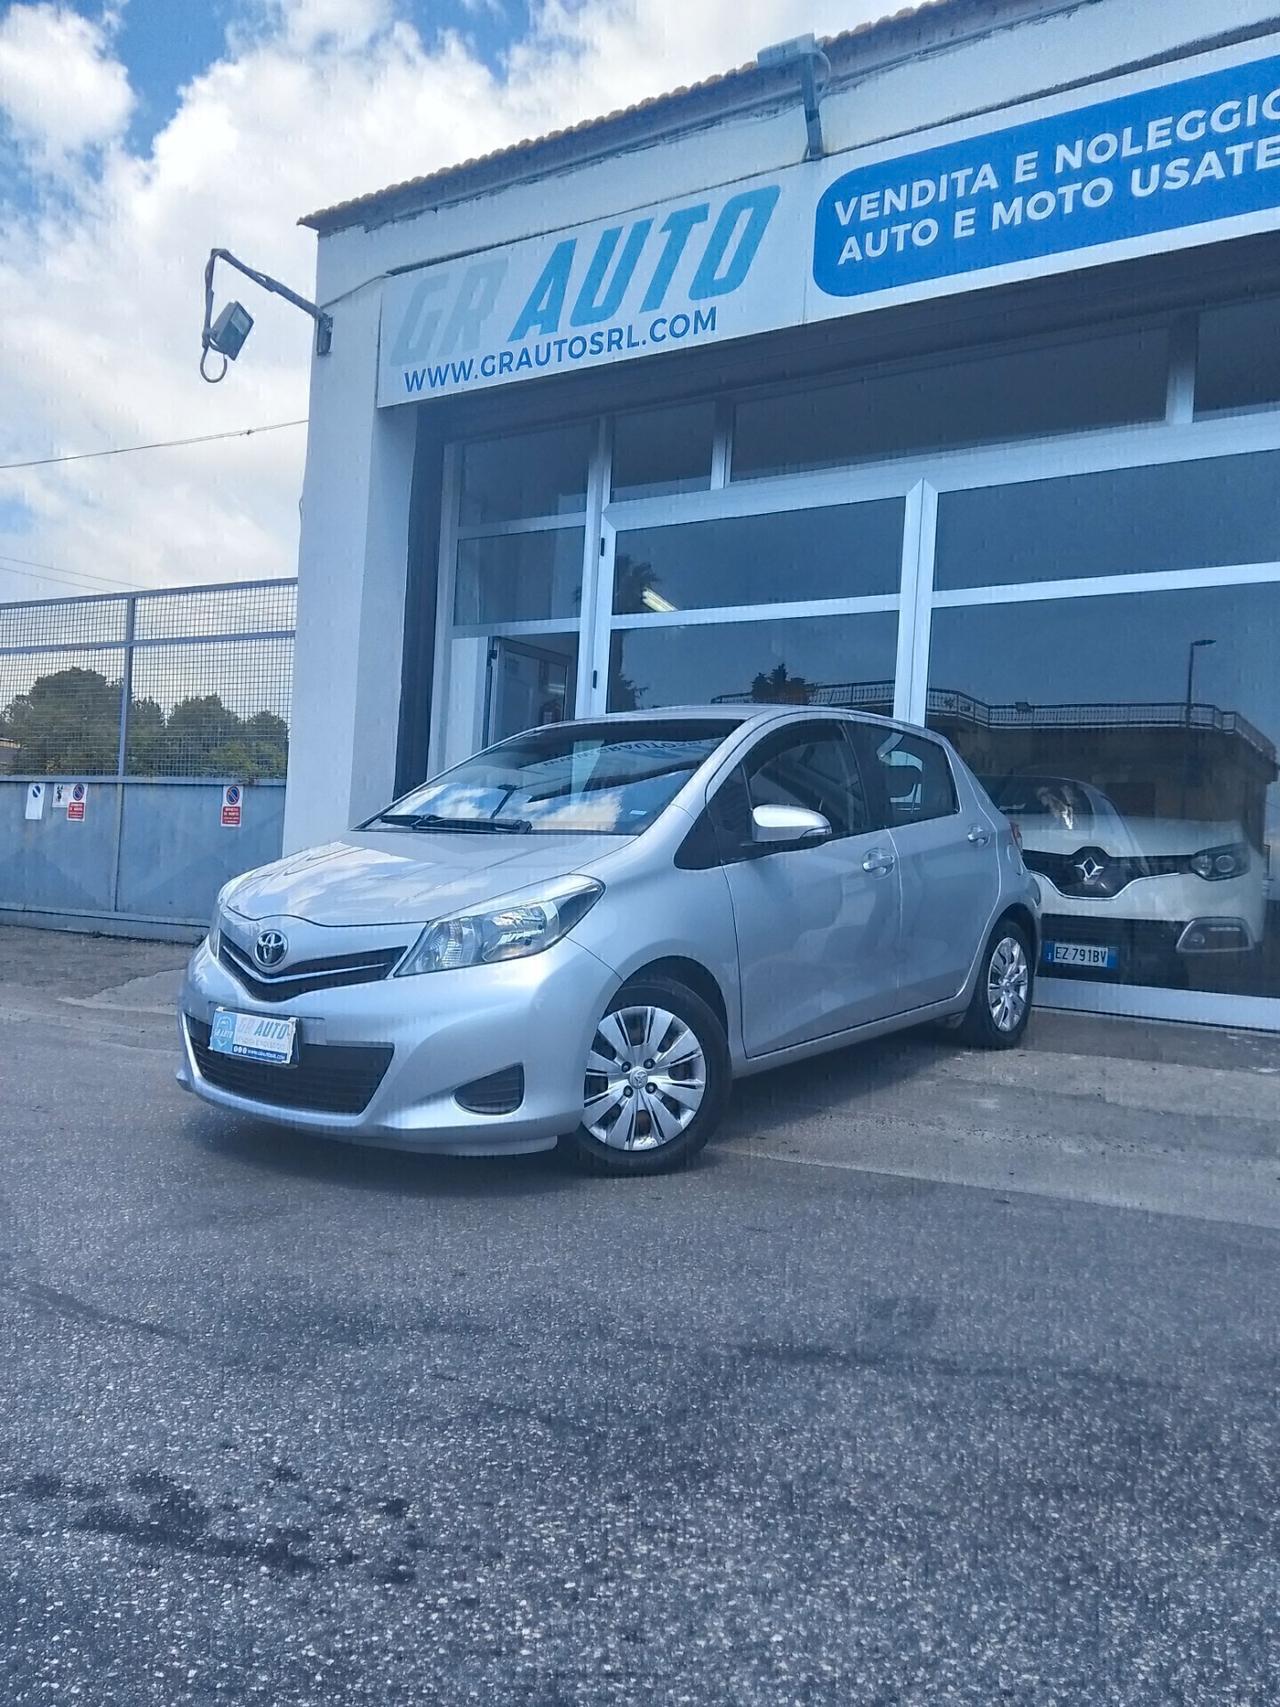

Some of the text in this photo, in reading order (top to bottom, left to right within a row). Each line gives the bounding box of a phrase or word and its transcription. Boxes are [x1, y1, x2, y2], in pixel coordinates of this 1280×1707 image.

[834, 163, 998, 226] VENDITA
[1014, 151, 1039, 184] E
[837, 134, 1280, 266] AUTO E MOTO USATE
[390, 184, 781, 367] GR AUTO
[404, 306, 718, 393] WWW.GRAUTOSRL.COM
[254, 1020, 289, 1040] AUTO
